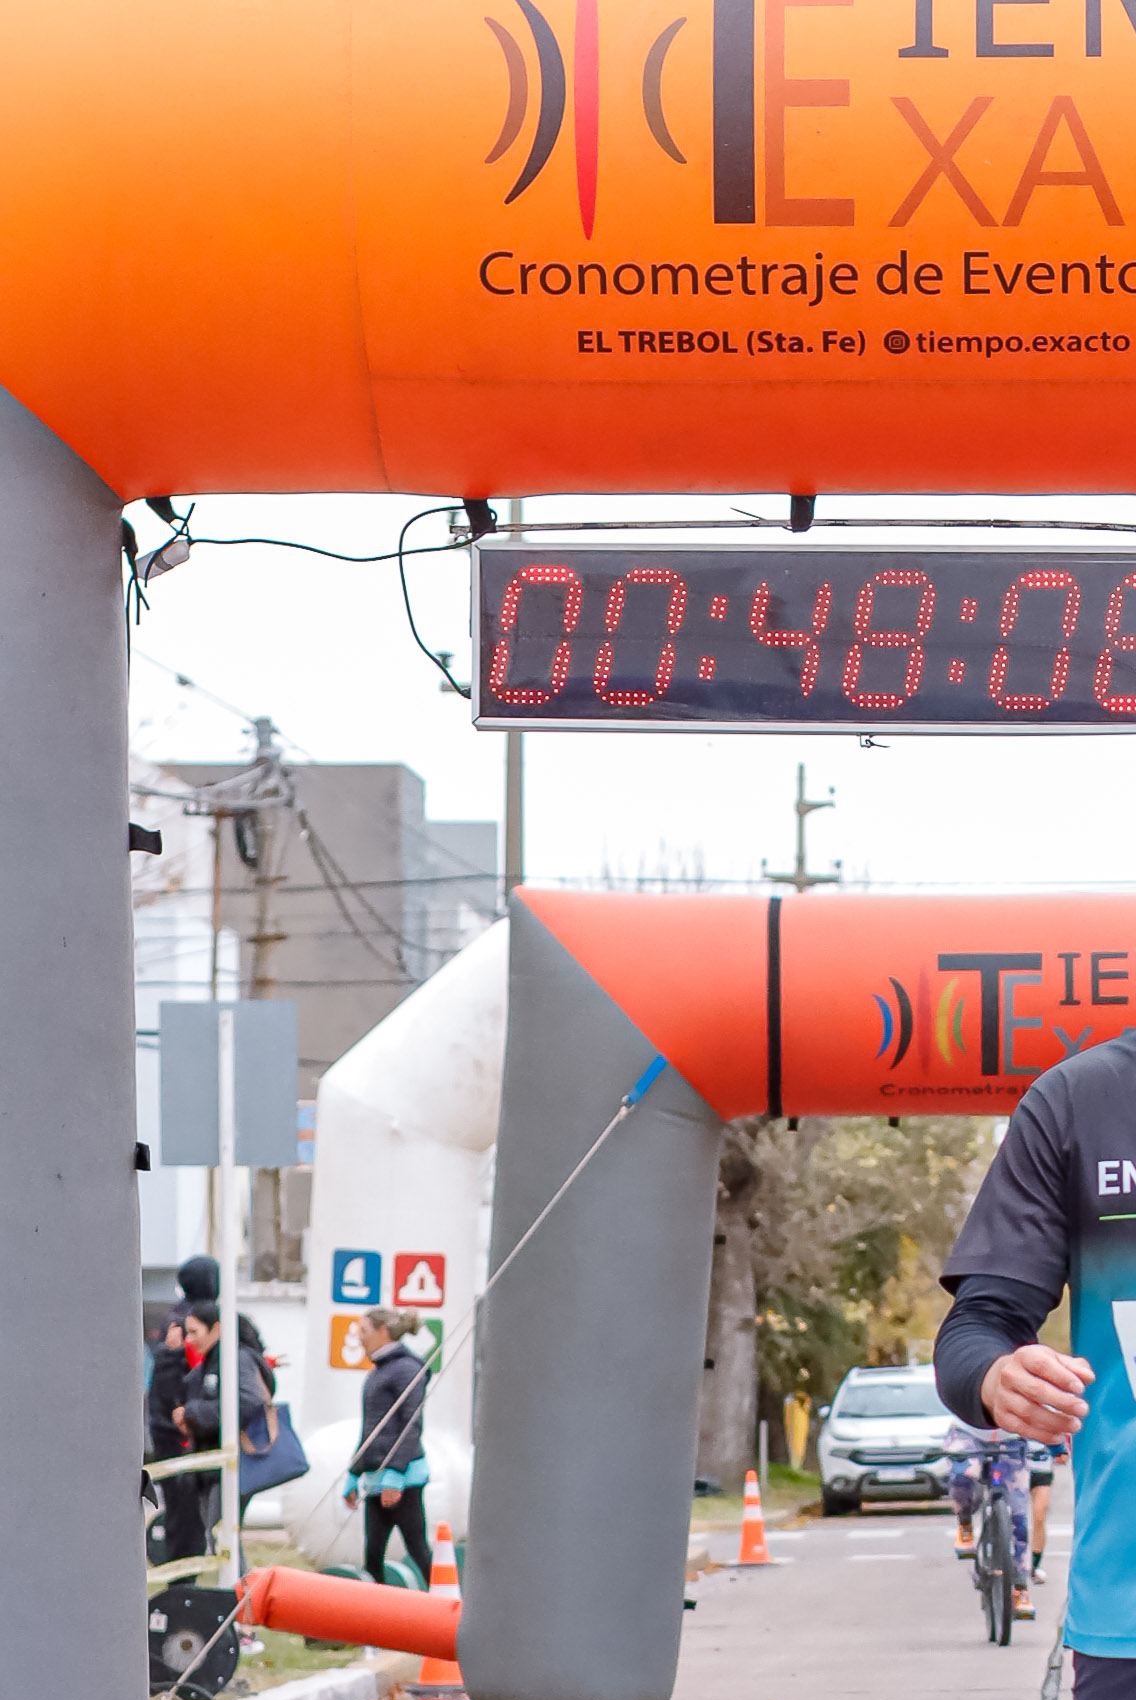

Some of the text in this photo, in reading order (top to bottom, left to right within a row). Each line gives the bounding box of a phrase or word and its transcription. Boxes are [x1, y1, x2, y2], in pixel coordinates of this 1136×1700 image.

[479, 251, 859, 307] Cronometraje
[876, 250, 943, 295] de
[578, 331, 612, 354] EL
[618, 330, 738, 354] TREBOL
[747, 330, 814, 358] (Sta.
[822, 330, 867, 357] Fe)
[916, 329, 1131, 358] tiempo.exacto
